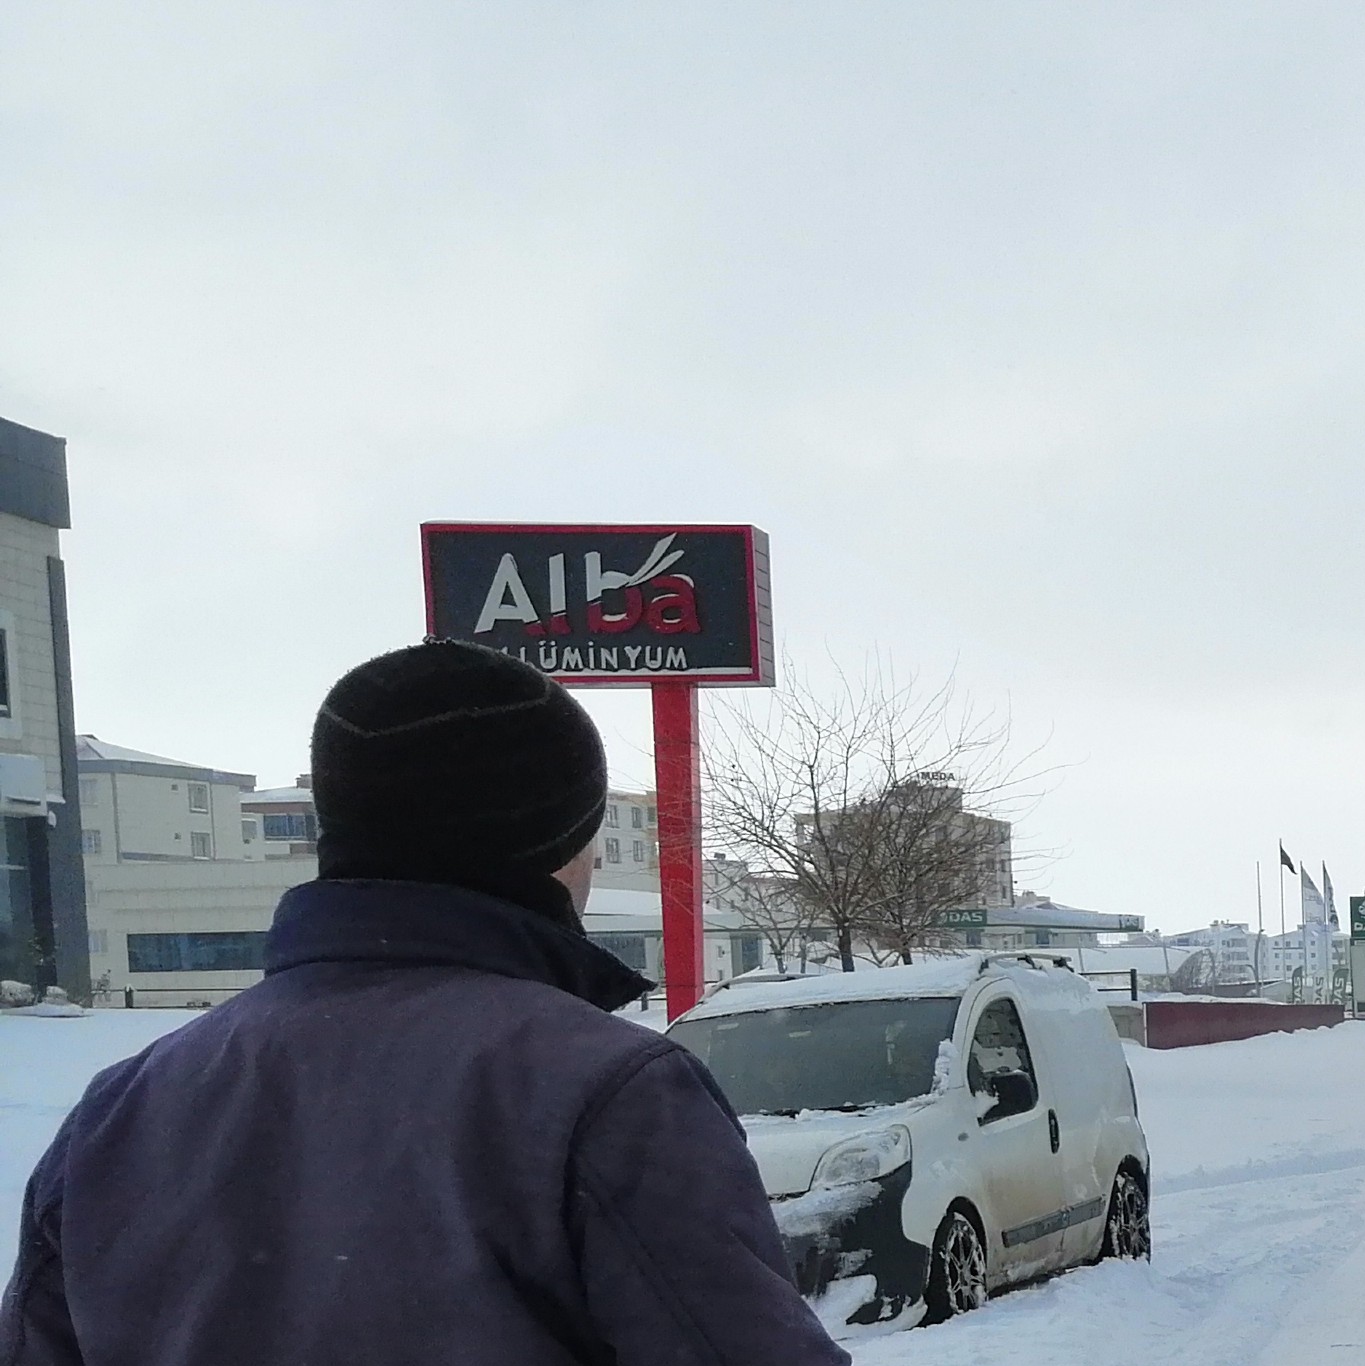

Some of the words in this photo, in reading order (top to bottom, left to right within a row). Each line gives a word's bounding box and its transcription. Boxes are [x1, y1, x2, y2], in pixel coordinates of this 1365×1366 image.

[474, 536, 703, 636] Alba
[500, 640, 688, 671] ÜMİNYUM
[949, 911, 984, 923] DAS
